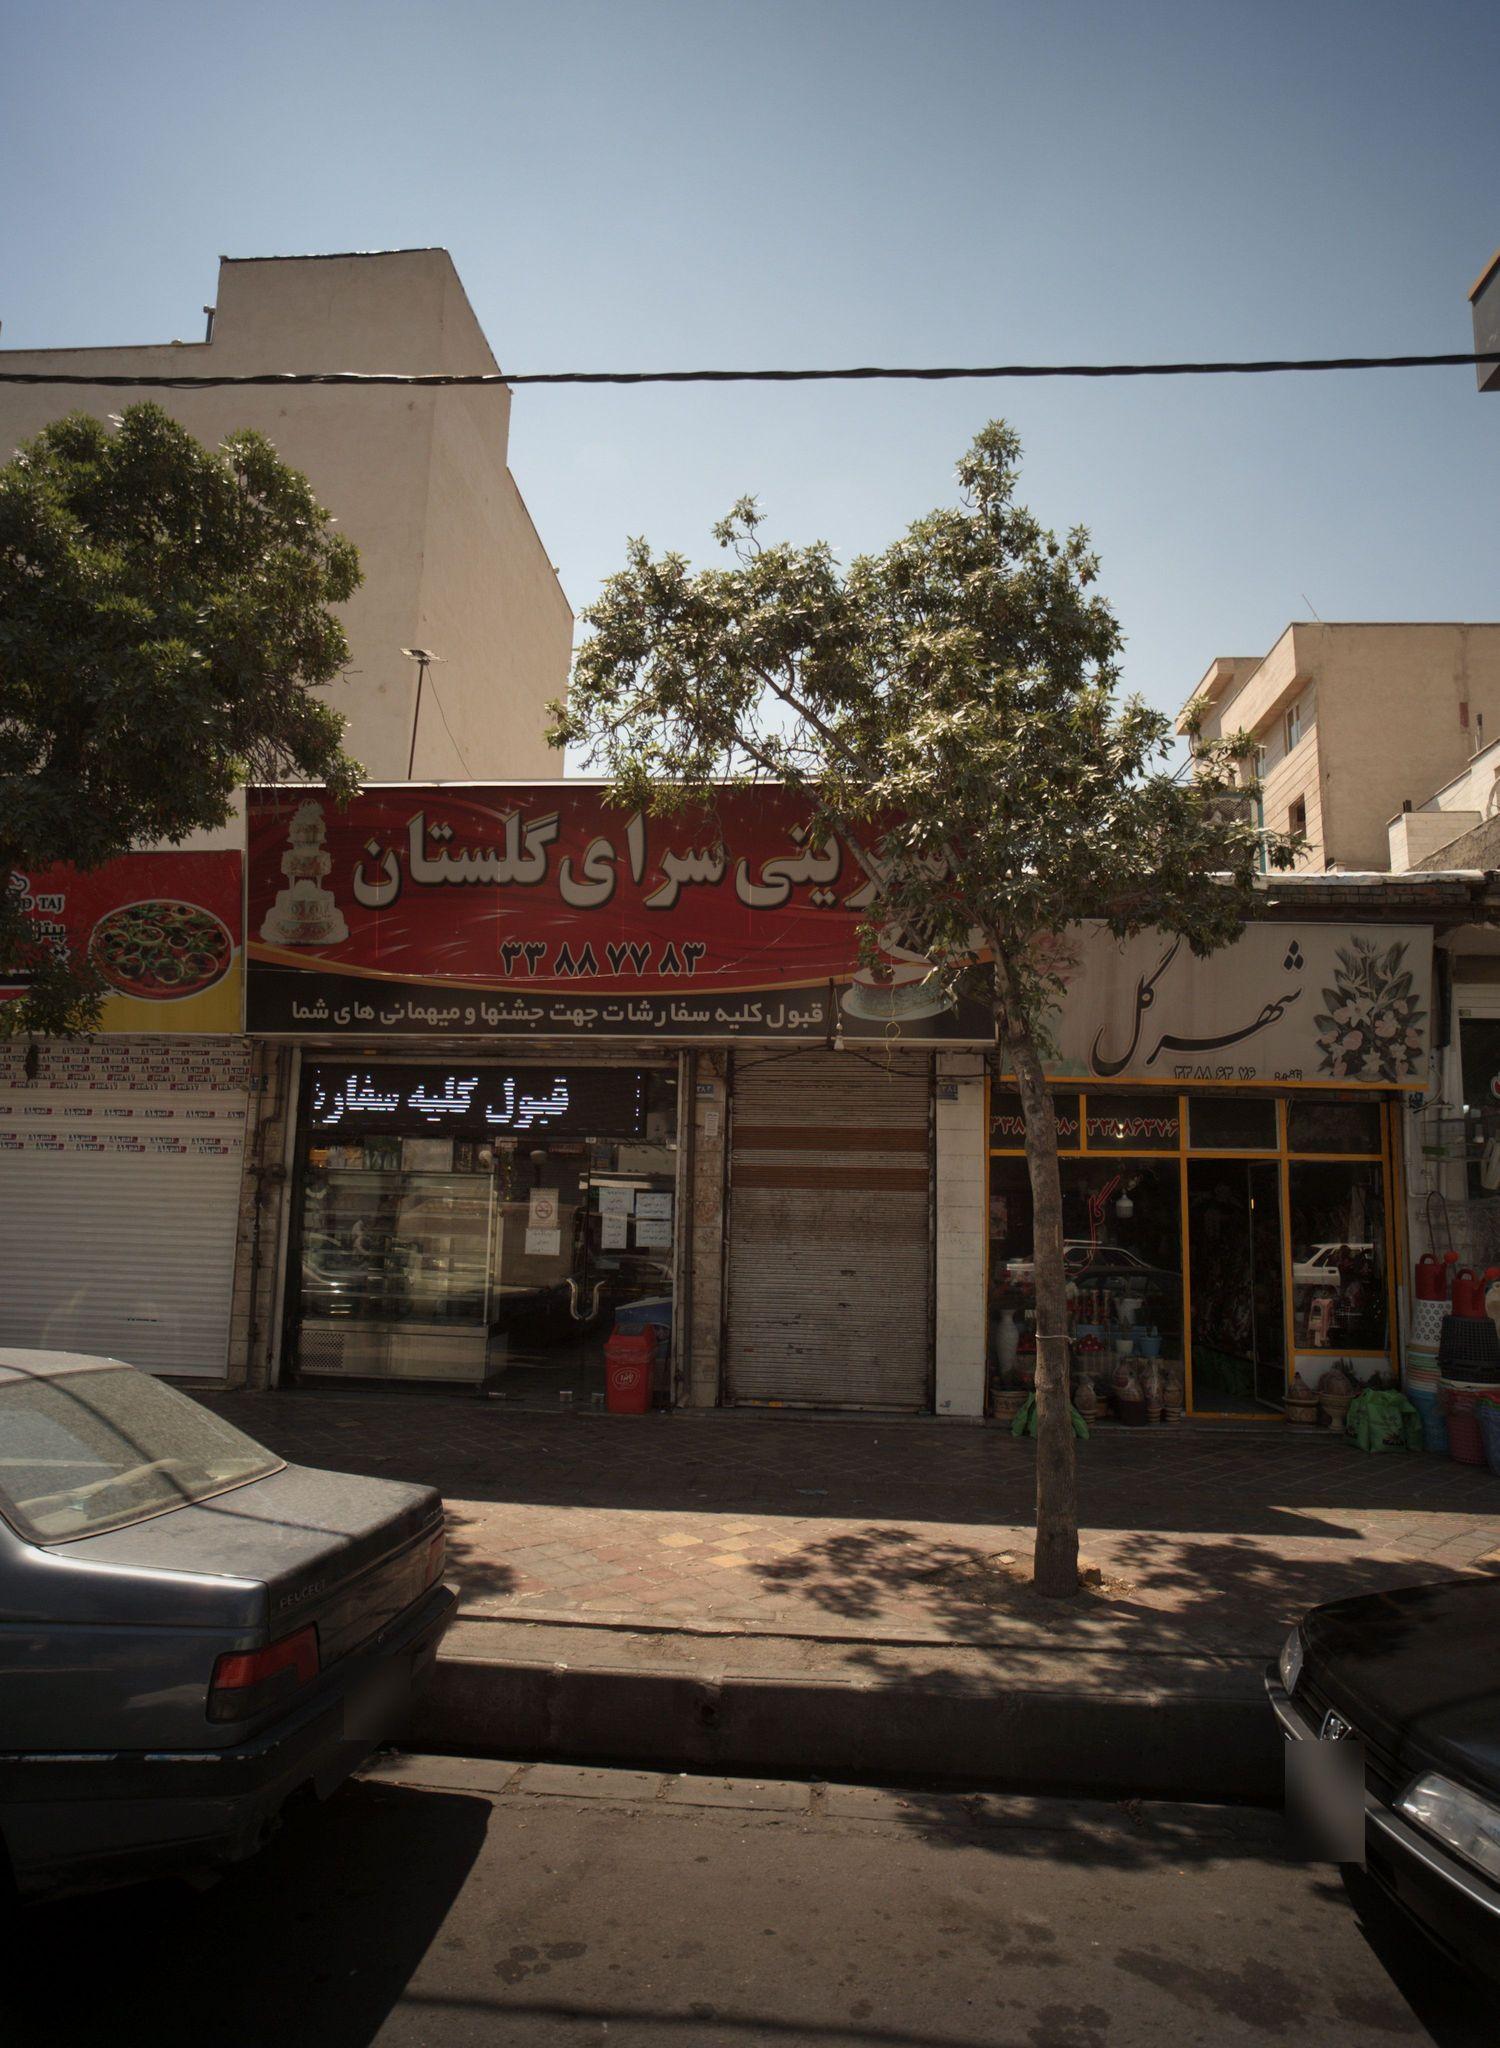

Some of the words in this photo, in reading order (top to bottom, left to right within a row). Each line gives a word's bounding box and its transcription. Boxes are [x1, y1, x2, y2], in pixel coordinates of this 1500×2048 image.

[353, 810, 560, 910] گلستان
[559, 811, 728, 910] سرای
[736, 820, 950, 911] رینی
[38, 895, 64, 913] TAJ
[500, 941, 547, 977] ۳۳
[554, 941, 599, 977] ۸۸
[606, 941, 651, 977] ۷۷
[658, 941, 706, 977] ۸۳
[292, 998, 329, 1021] شما
[334, 1001, 375, 1025] های
[379, 1000, 460, 1026] میهمانی
[464, 1007, 475, 1026] و
[480, 998, 545, 1028] جشنها
[549, 1003, 599, 1028] جهت
[602, 1000, 711, 1028] سفارشات
[714, 1003, 763, 1030] کلیه
[766, 1003, 824, 1029] قبول
[1091, 931, 1183, 1077] گل
[1146, 940, 1304, 1065] شهر
[407, 1076, 479, 1122] کلیه
[485, 1077, 569, 1129] قبول
[990, 1116, 1079, 1136] ۳۳۸۸۰
